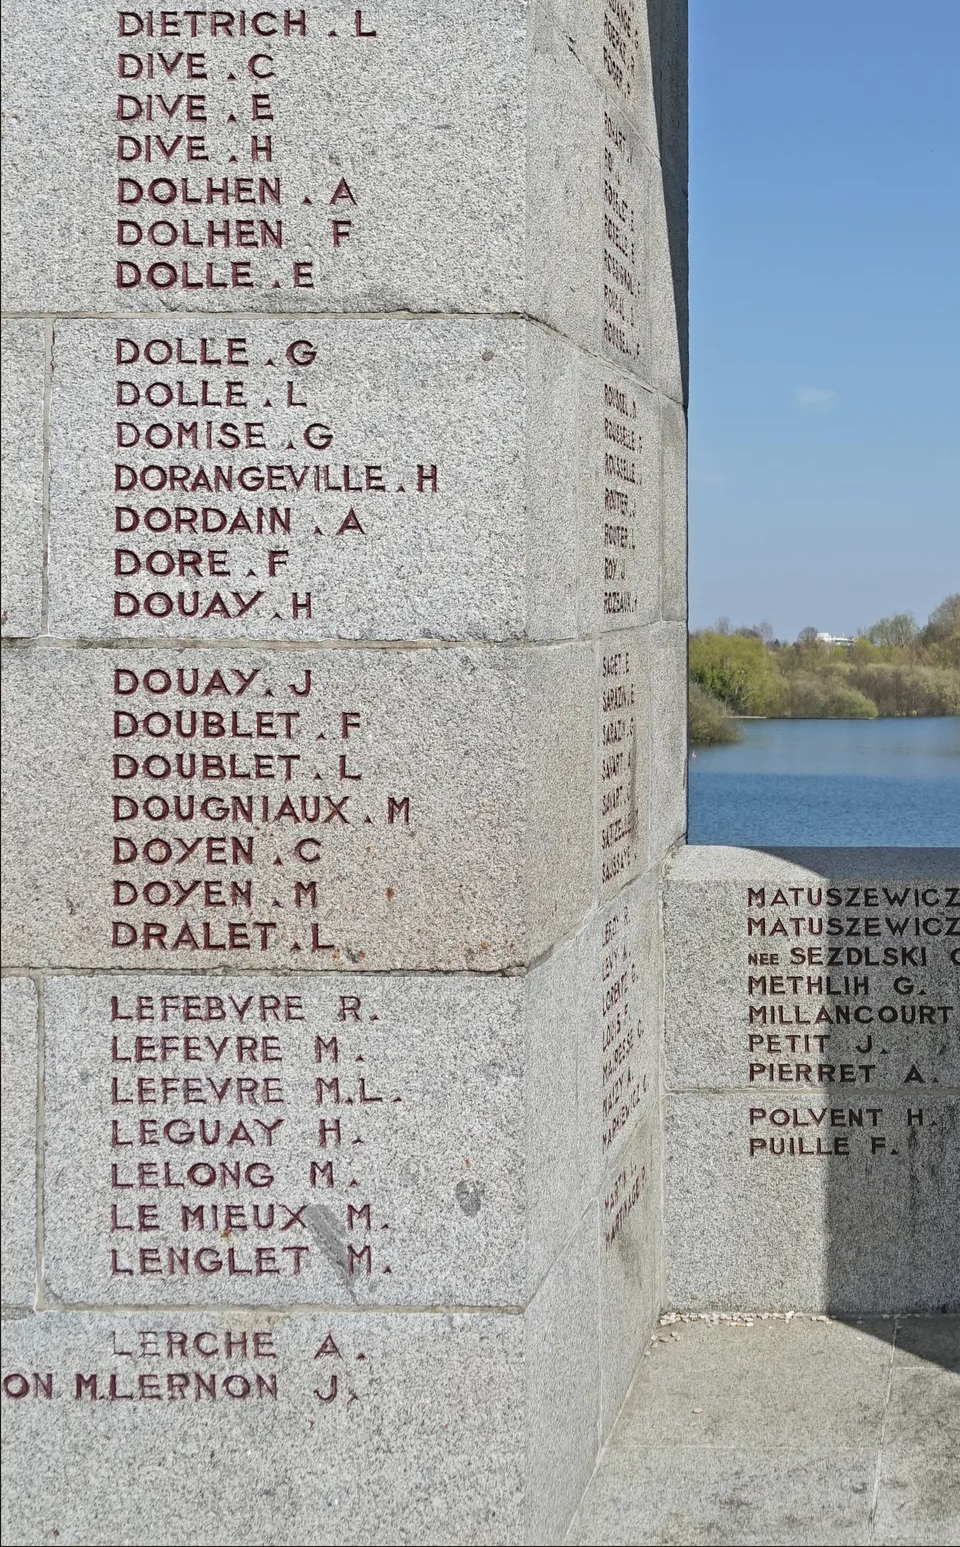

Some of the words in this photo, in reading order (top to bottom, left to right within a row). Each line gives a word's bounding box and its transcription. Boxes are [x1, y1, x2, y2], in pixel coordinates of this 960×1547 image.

[747, 952, 780, 966] NEE
[747, 1004, 954, 1026] MILLANCOURT
[746, 1033, 832, 1054] PETIT
[748, 1062, 876, 1084] PIERRET
[748, 1106, 883, 1128] POLVENT
[748, 1136, 851, 1157] PUILLE
[180, 1203, 309, 1228] MIEUX
[111, 1331, 278, 1359] LERCHE
